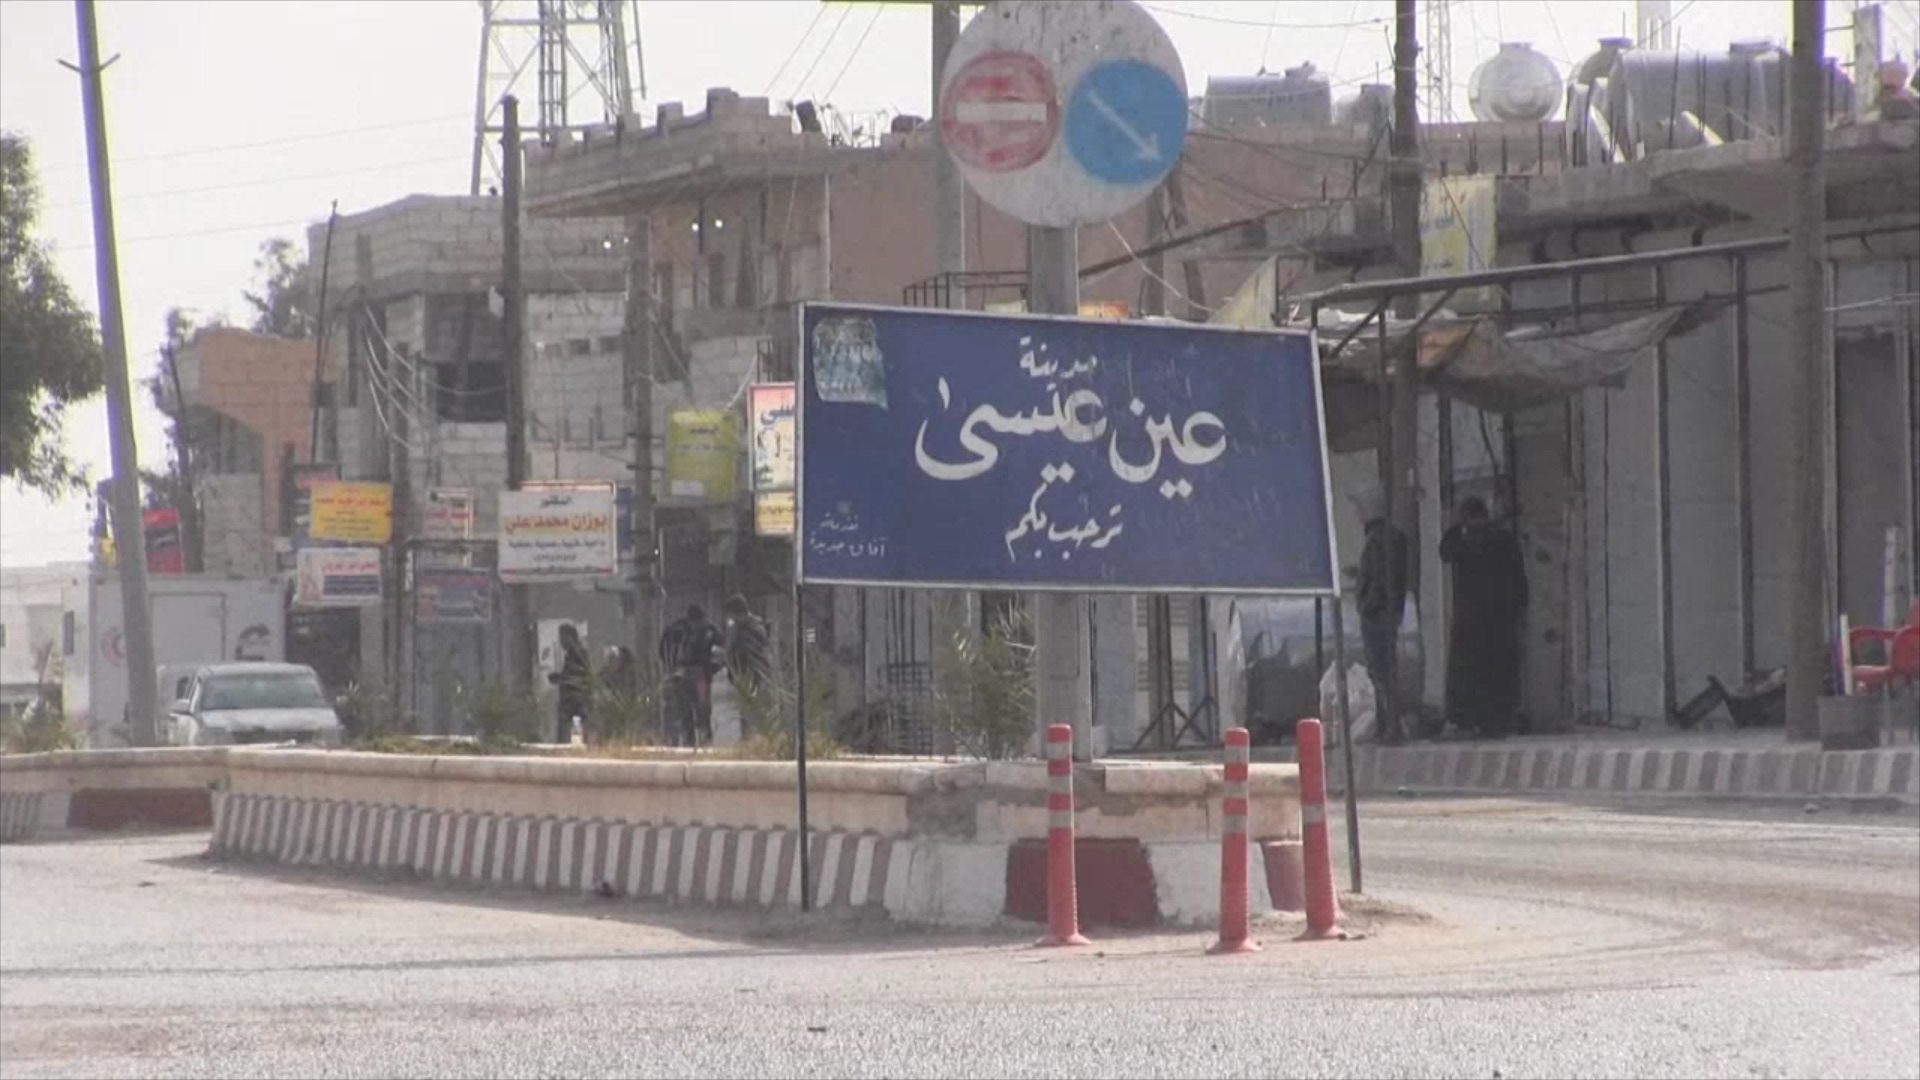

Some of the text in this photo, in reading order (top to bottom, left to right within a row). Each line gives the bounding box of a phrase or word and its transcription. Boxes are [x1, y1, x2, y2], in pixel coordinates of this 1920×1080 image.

[1020, 336, 1097, 378] مدينة
[914, 376, 1227, 499] عين عيسى
[1005, 482, 1123, 563] ترحب بكم
